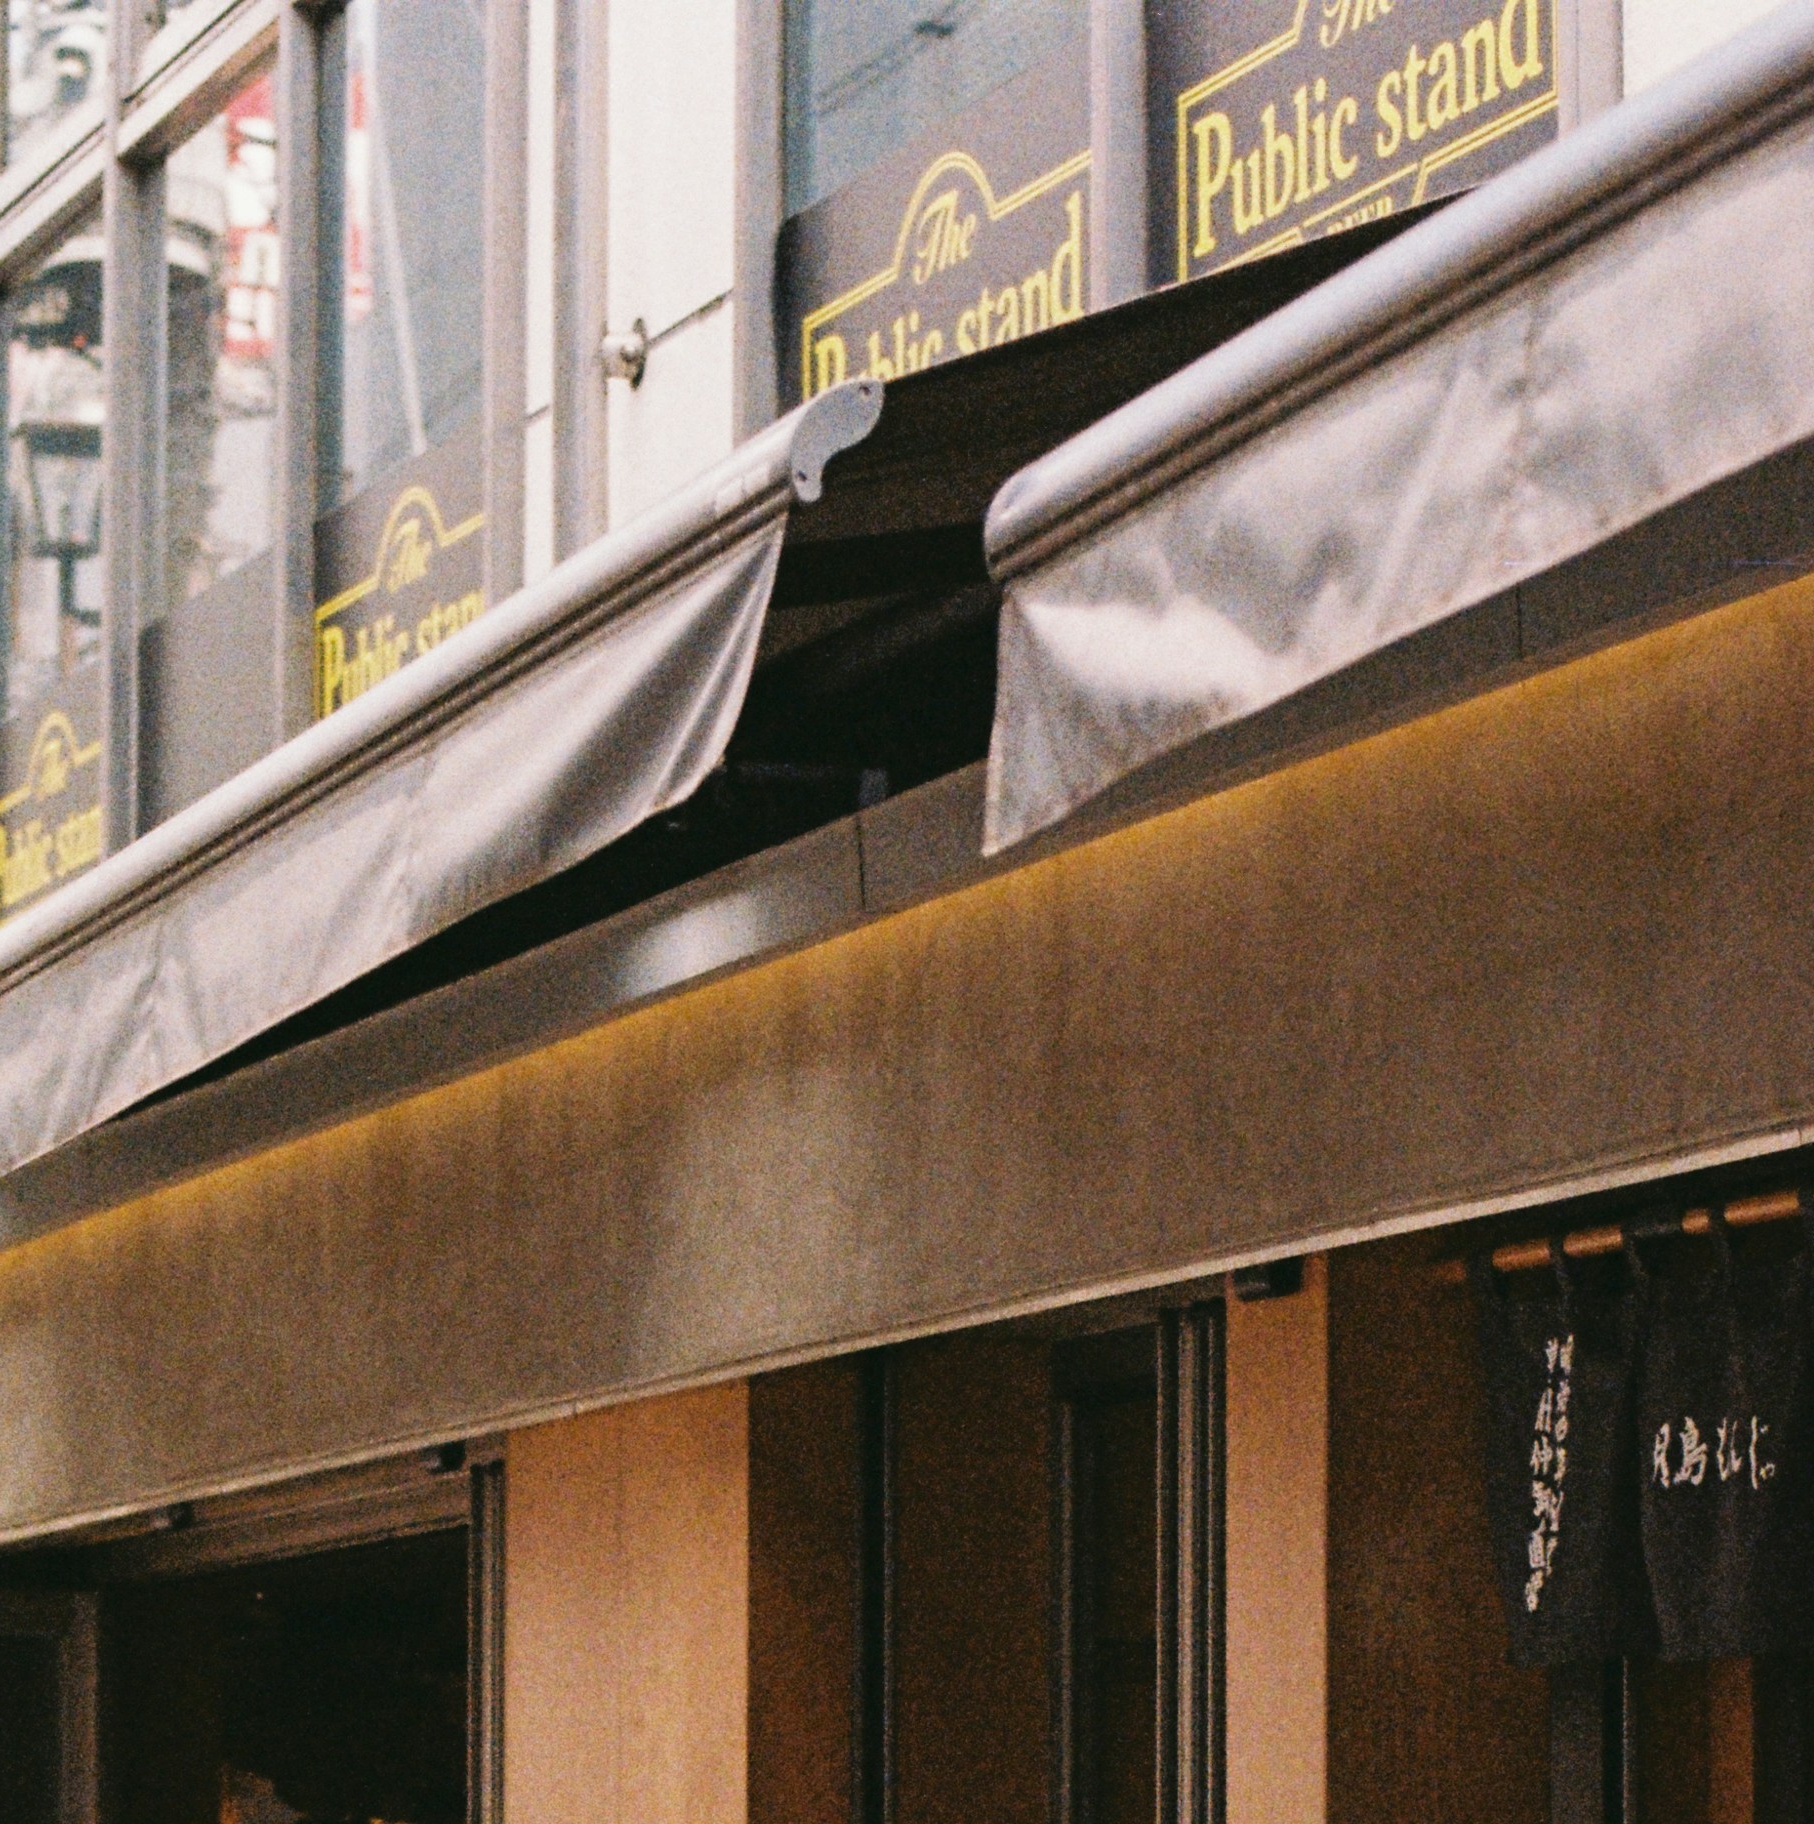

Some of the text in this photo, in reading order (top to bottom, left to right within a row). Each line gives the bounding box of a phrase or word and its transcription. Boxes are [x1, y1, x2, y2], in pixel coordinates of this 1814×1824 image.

[1192, 0, 1543, 258] Public stand
[912, 190, 977, 285] The
